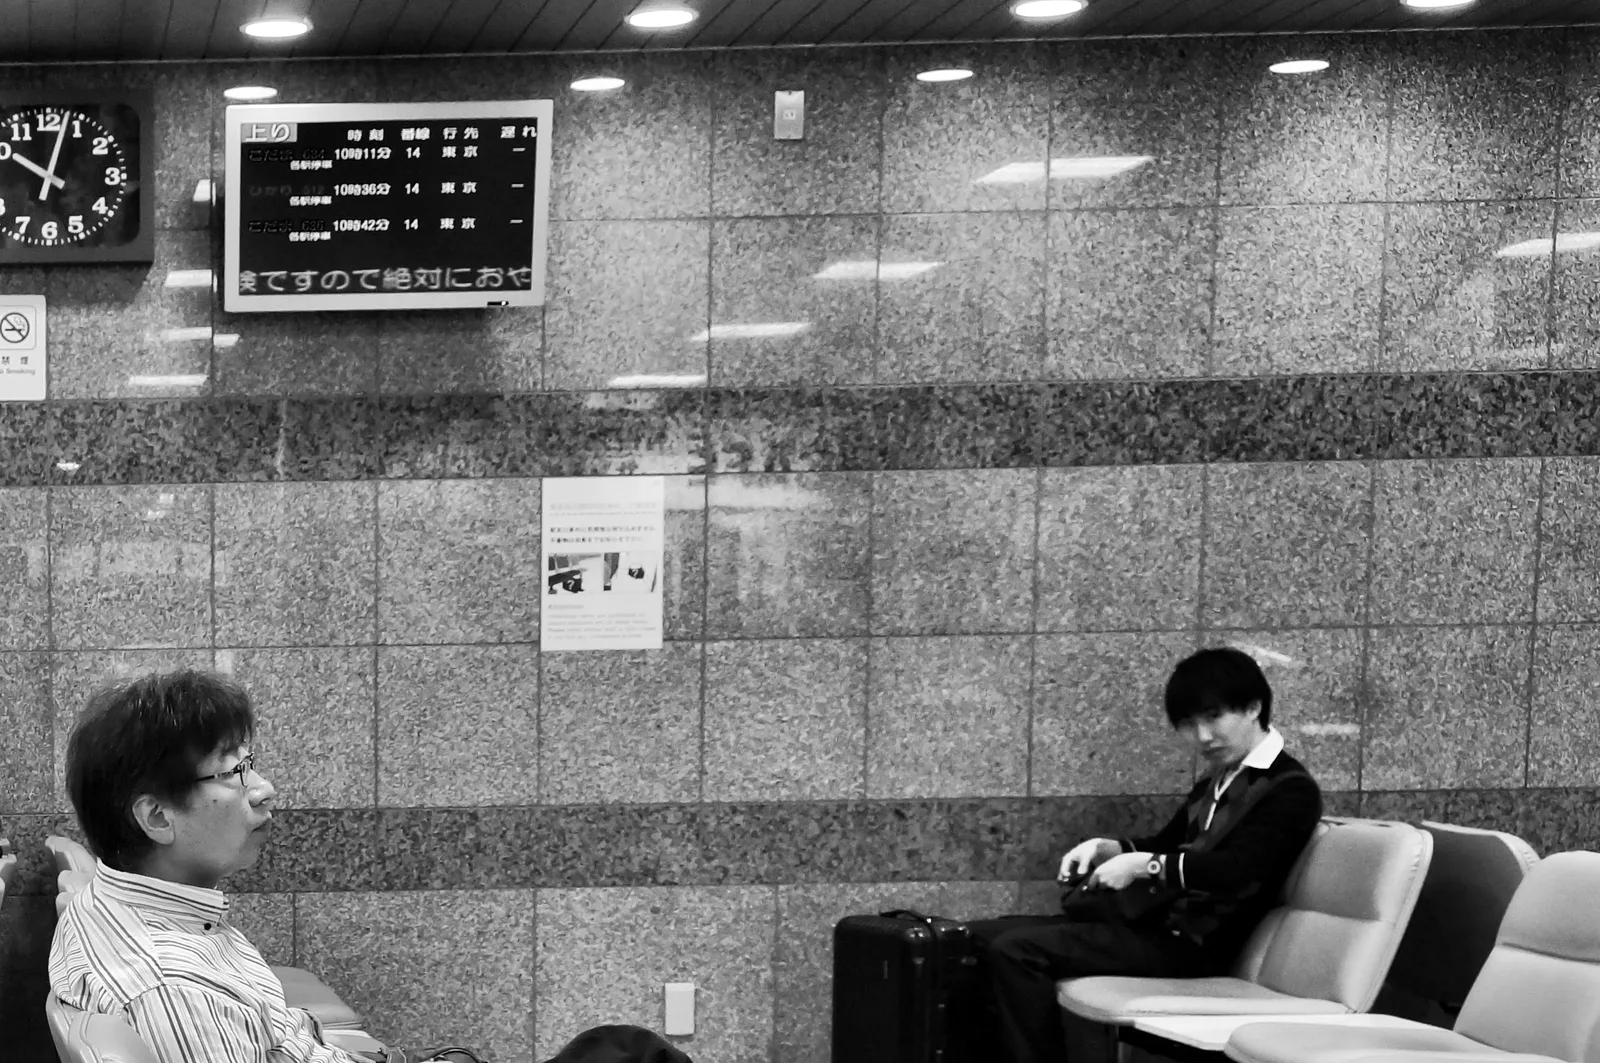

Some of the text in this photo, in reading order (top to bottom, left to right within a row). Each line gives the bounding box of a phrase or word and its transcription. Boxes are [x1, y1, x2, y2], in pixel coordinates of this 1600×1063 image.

[36, 113, 61, 131] 12
[72, 120, 82, 138] 1
[11, 123, 32, 141] 11
[245, 123, 290, 142] 上り
[92, 136, 109, 155] 2
[405, 147, 421, 159] 14
[104, 167, 121, 186] 3
[404, 182, 420, 195] 14
[92, 196, 108, 214] 4
[15, 216, 31, 235] 7
[41, 221, 58, 240] 6
[68, 215, 84, 234] 5
[404, 219, 419, 230] 14
